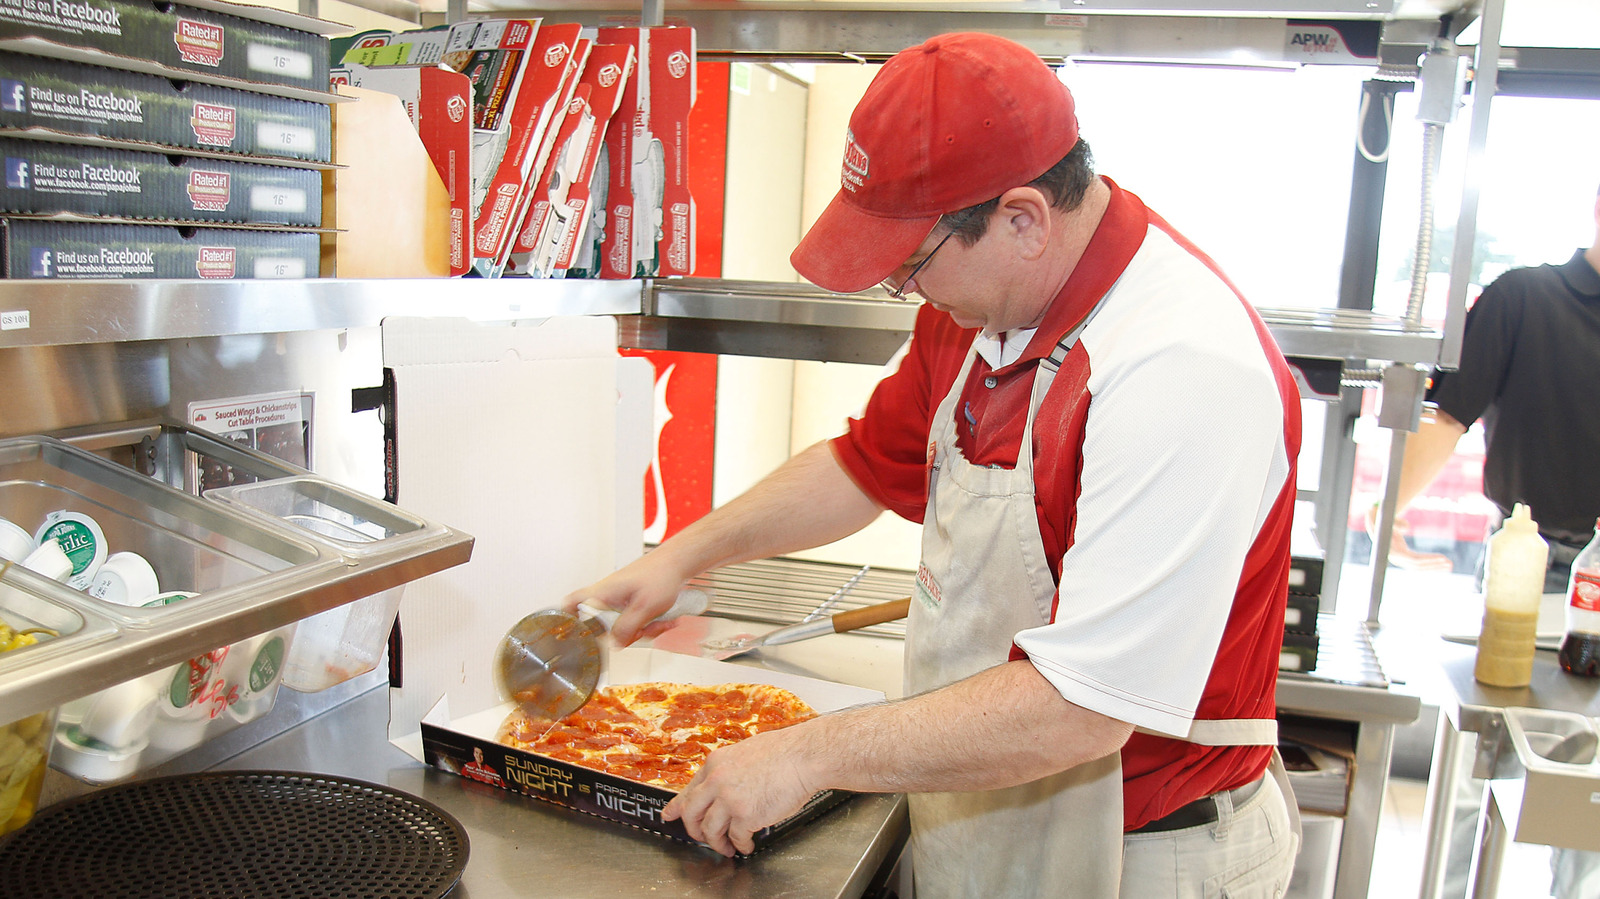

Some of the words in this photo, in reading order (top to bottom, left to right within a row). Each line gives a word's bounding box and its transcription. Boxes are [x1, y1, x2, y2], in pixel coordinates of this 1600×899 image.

[0, 6, 122, 36] www.facebook.com/papajohns
[37, 1, 51, 13] on
[53, 0, 121, 26] Facebook
[183, 22, 210, 39] Rated
[210, 30, 219, 41] #1
[1291, 33, 1329, 45] APW
[30, 87, 53, 102] Find
[55, 93, 66, 104] us
[67, 95, 80, 105] on
[81, 89, 143, 114] Facebook
[491, 88, 504, 109] PIZZA!
[30, 101, 143, 123] www.facebook.com/papajohns
[198, 106, 224, 121] Rated
[223, 111, 232, 122] #1
[488, 109, 497, 119] XL
[34, 164, 55, 178] Find
[56, 168, 68, 178] us
[69, 169, 80, 179] on
[82, 163, 141, 184] Facebook
[194, 173, 218, 186] Rated
[219, 176, 227, 187] #1
[34, 177, 141, 193] www.facebook.com/papajohns
[57, 251, 77, 264] Find
[78, 254, 88, 264] us
[88, 254, 99, 264] on
[100, 247, 154, 265] Facebook
[203, 250, 225, 261] Rated
[225, 251, 232, 261] #1
[56, 264, 154, 274] www.facebook.com/papajohns
[2, 316, 12, 324] GS
[215, 409, 237, 419] Sauced
[237, 407, 255, 417] Wings
[256, 406, 260, 414] &
[261, 402, 298, 413] Chickenstrips
[228, 418, 238, 428] Cut
[239, 416, 254, 425] Table
[255, 413, 286, 423] Procedures
[60, 533, 89, 552] rlic
[504, 755, 573, 781] SUNDAY
[506, 767, 573, 797] NIGHT
[578, 783, 591, 794] IS
[595, 782, 628, 798] PAPA
[630, 793, 668, 807] JOHN'S
